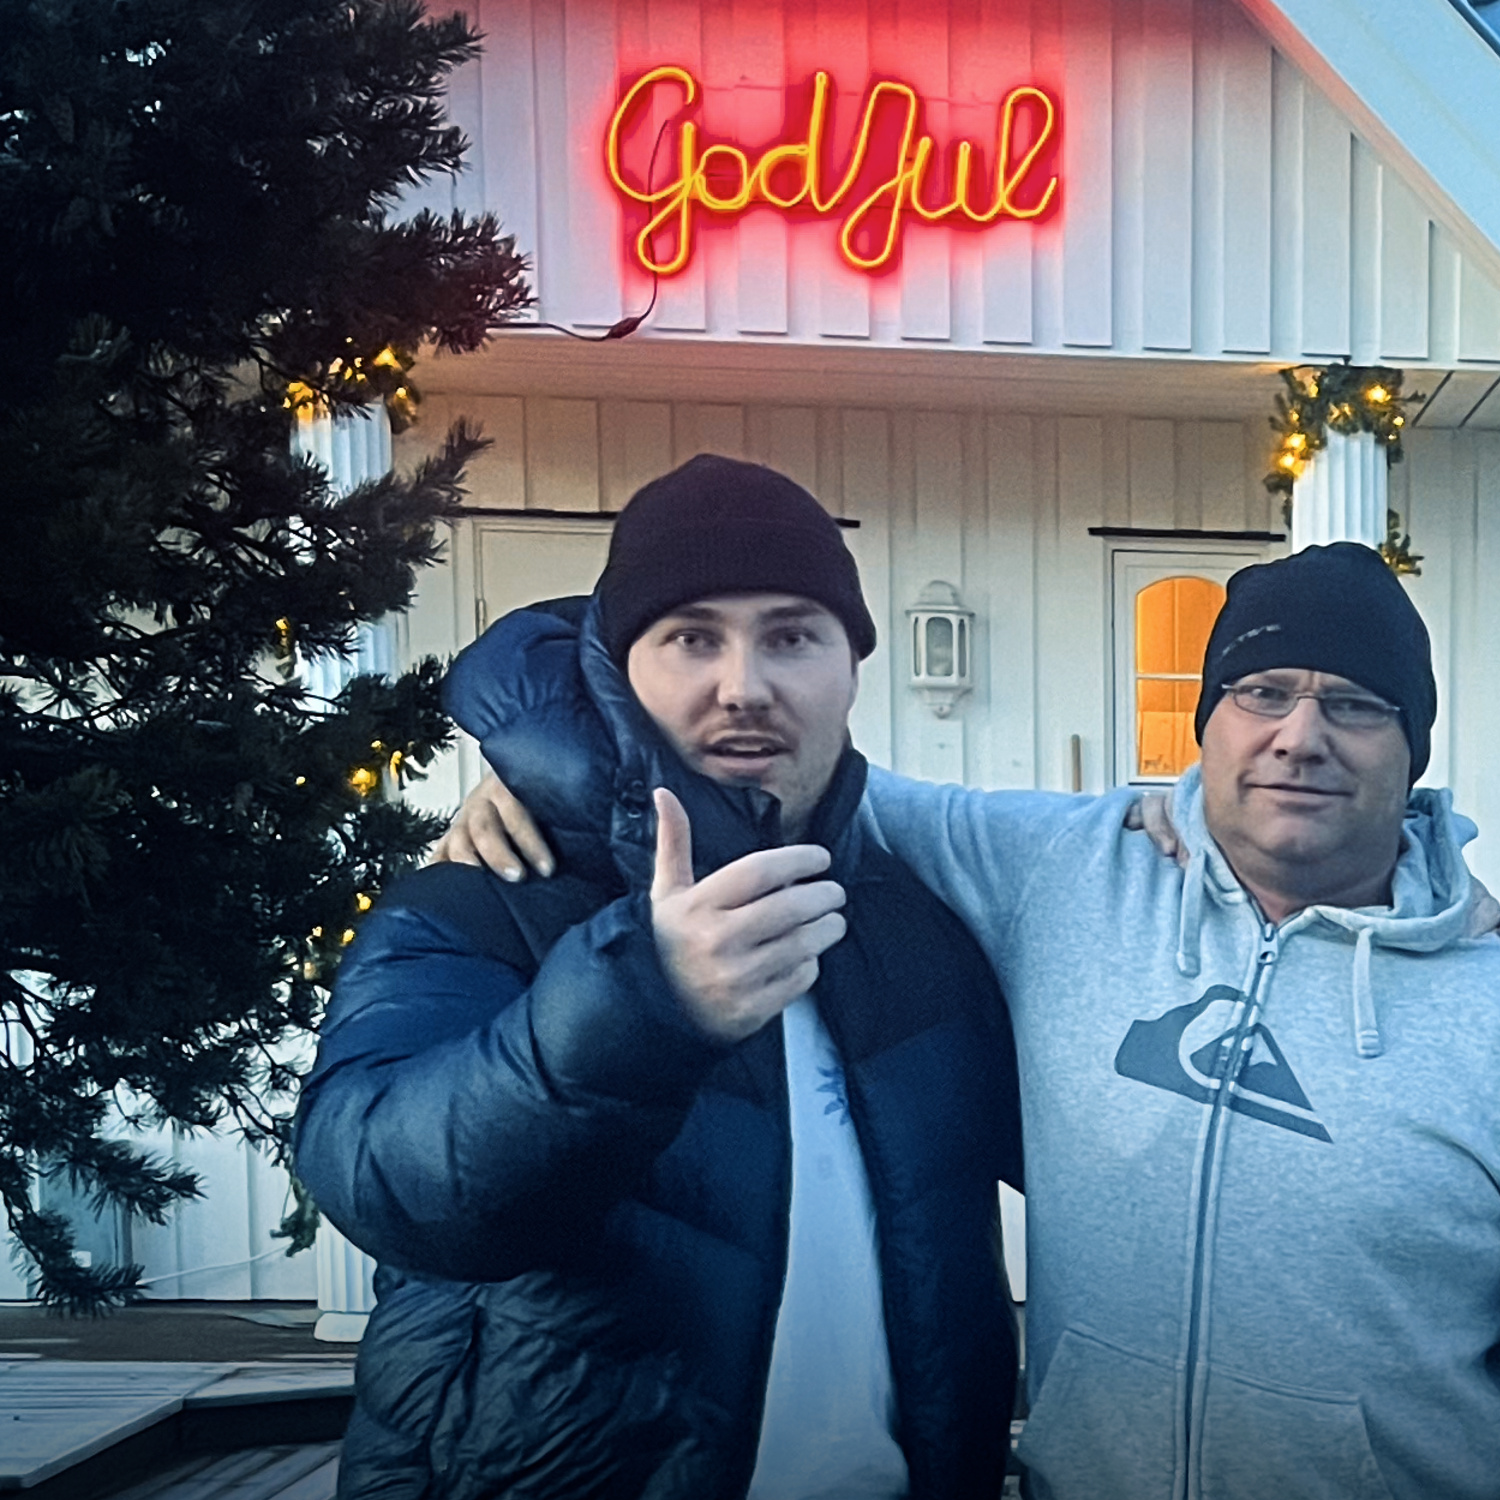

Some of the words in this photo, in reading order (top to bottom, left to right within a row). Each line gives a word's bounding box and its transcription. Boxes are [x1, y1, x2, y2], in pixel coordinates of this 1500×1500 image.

[608, 66, 830, 274] God
[841, 81, 1058, 266] Jul
[865, 614, 944, 687] 10
